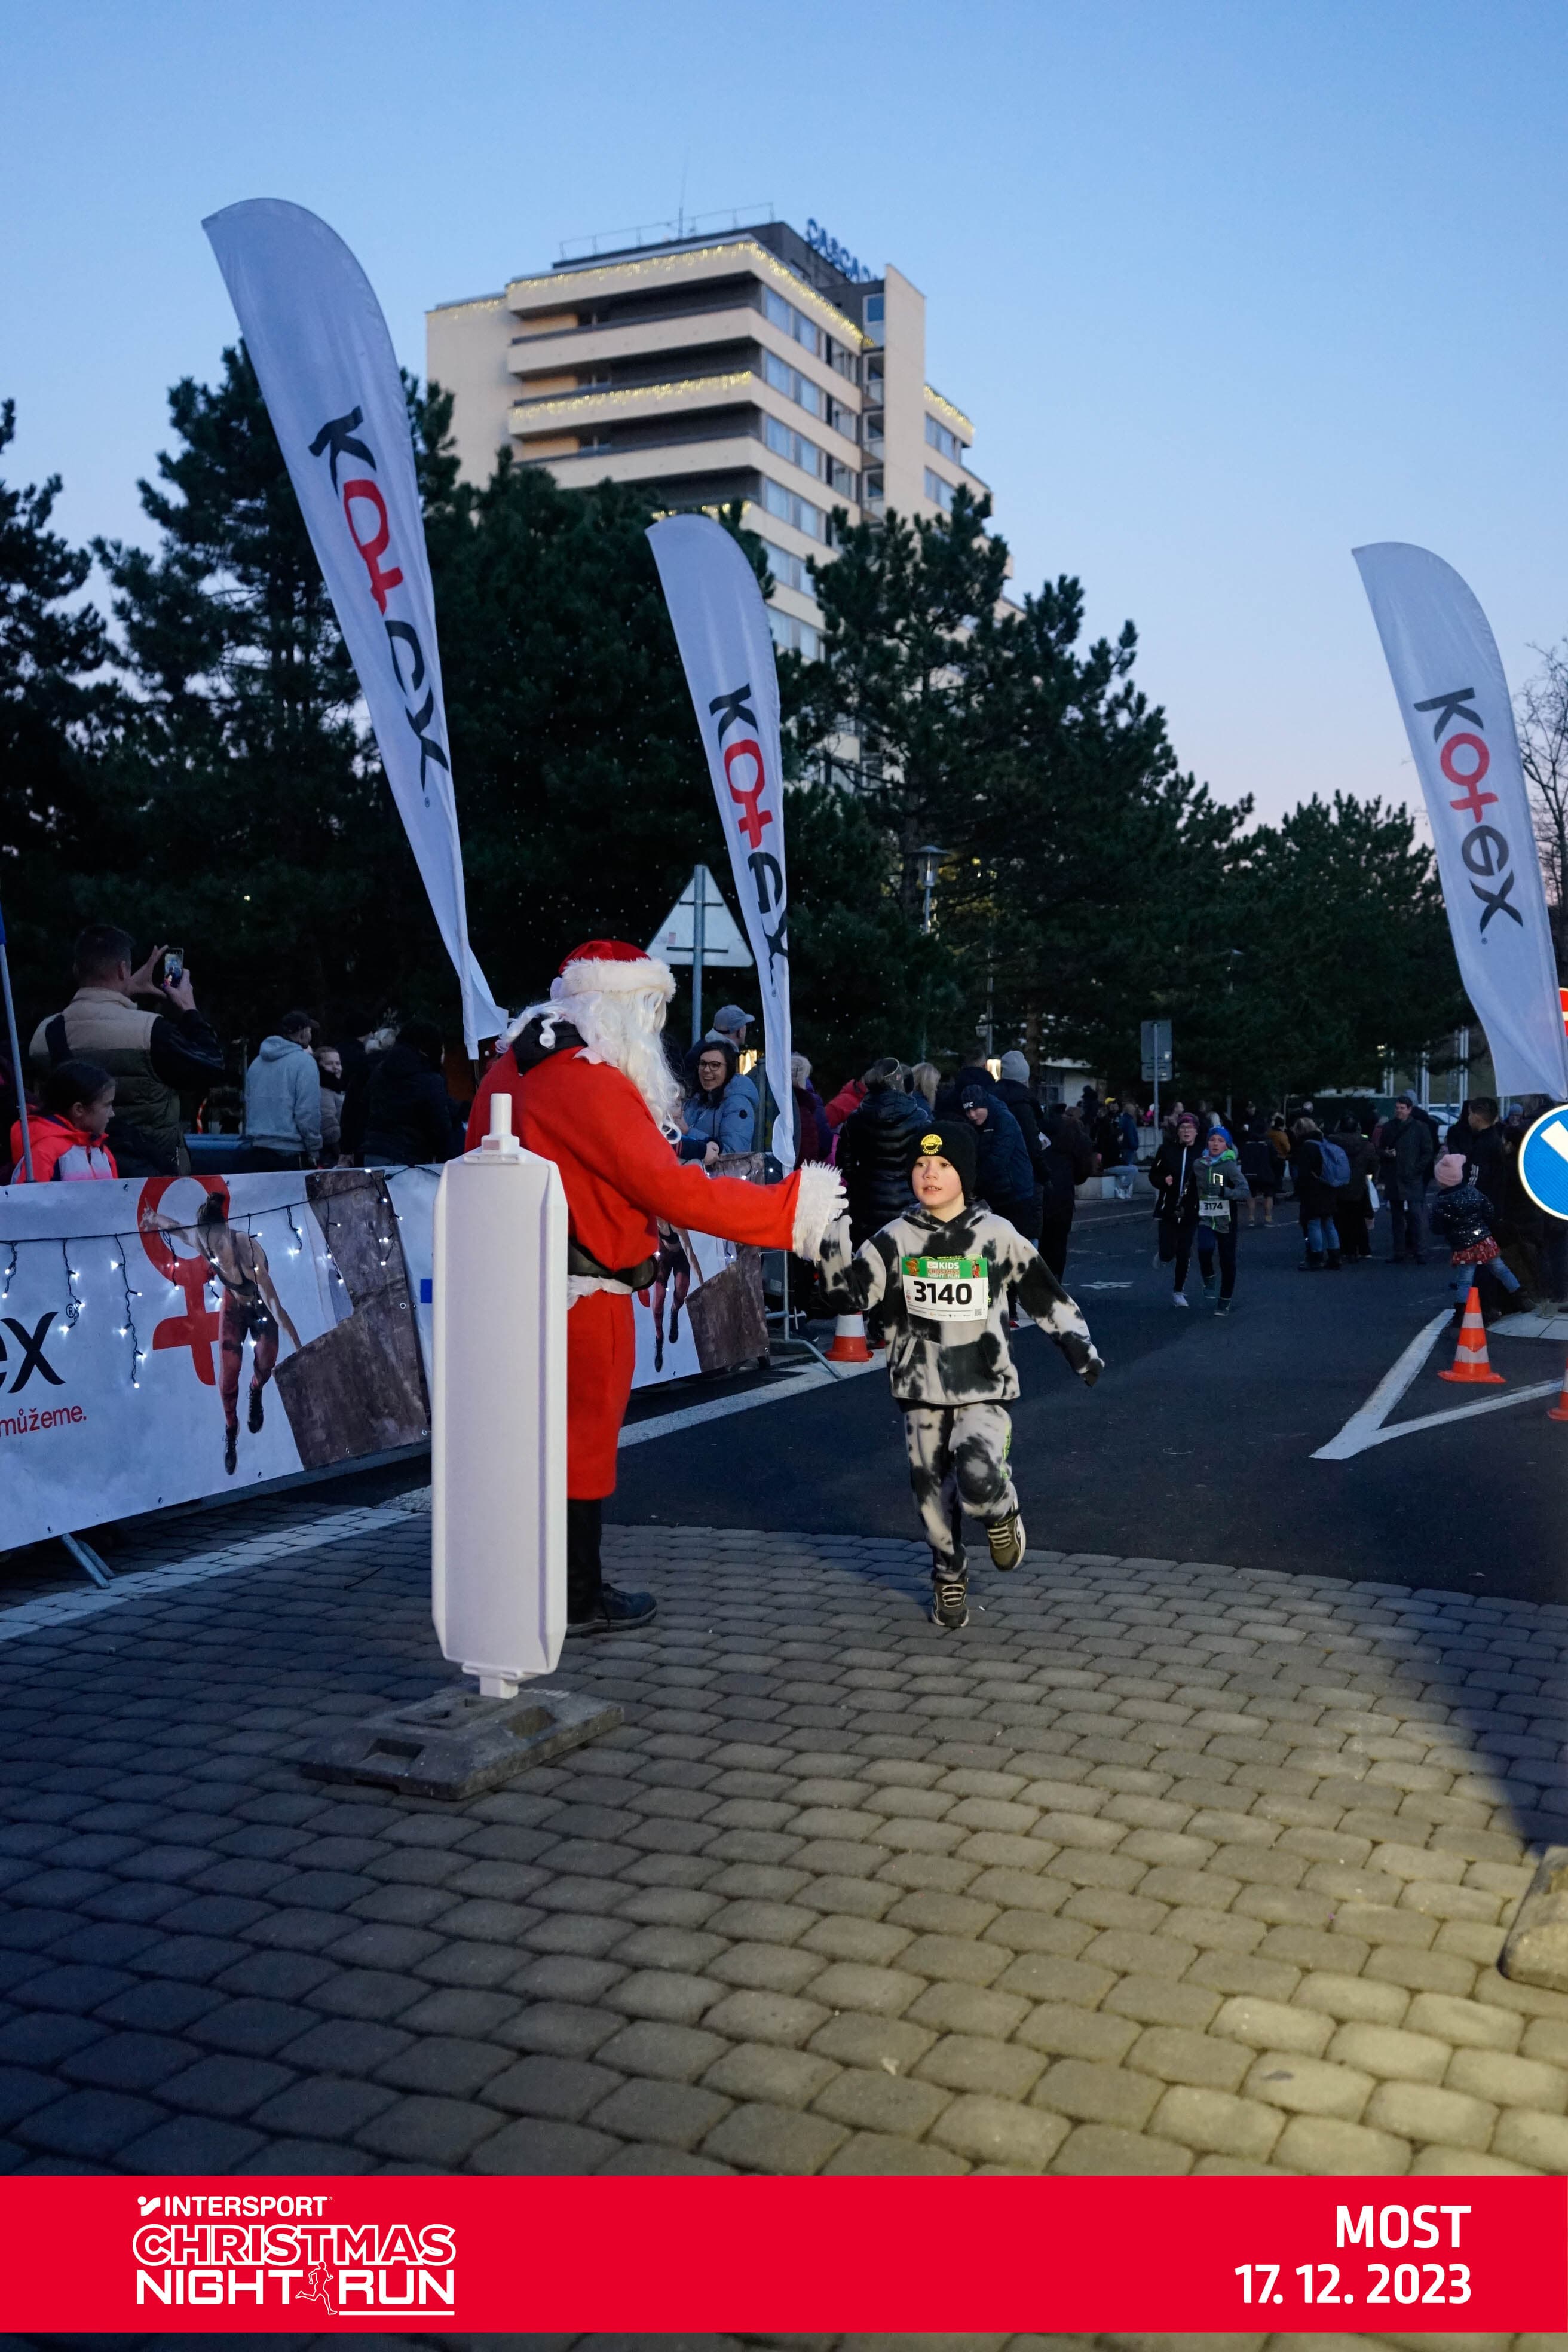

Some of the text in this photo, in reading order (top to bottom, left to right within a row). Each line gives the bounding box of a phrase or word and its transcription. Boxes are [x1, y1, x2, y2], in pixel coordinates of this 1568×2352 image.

[807, 218, 877, 283] CASCA
[1413, 687, 1523, 934] Kotex
[1203, 1202, 1223, 1210] 3174
[913, 1280, 972, 1305] 3140
